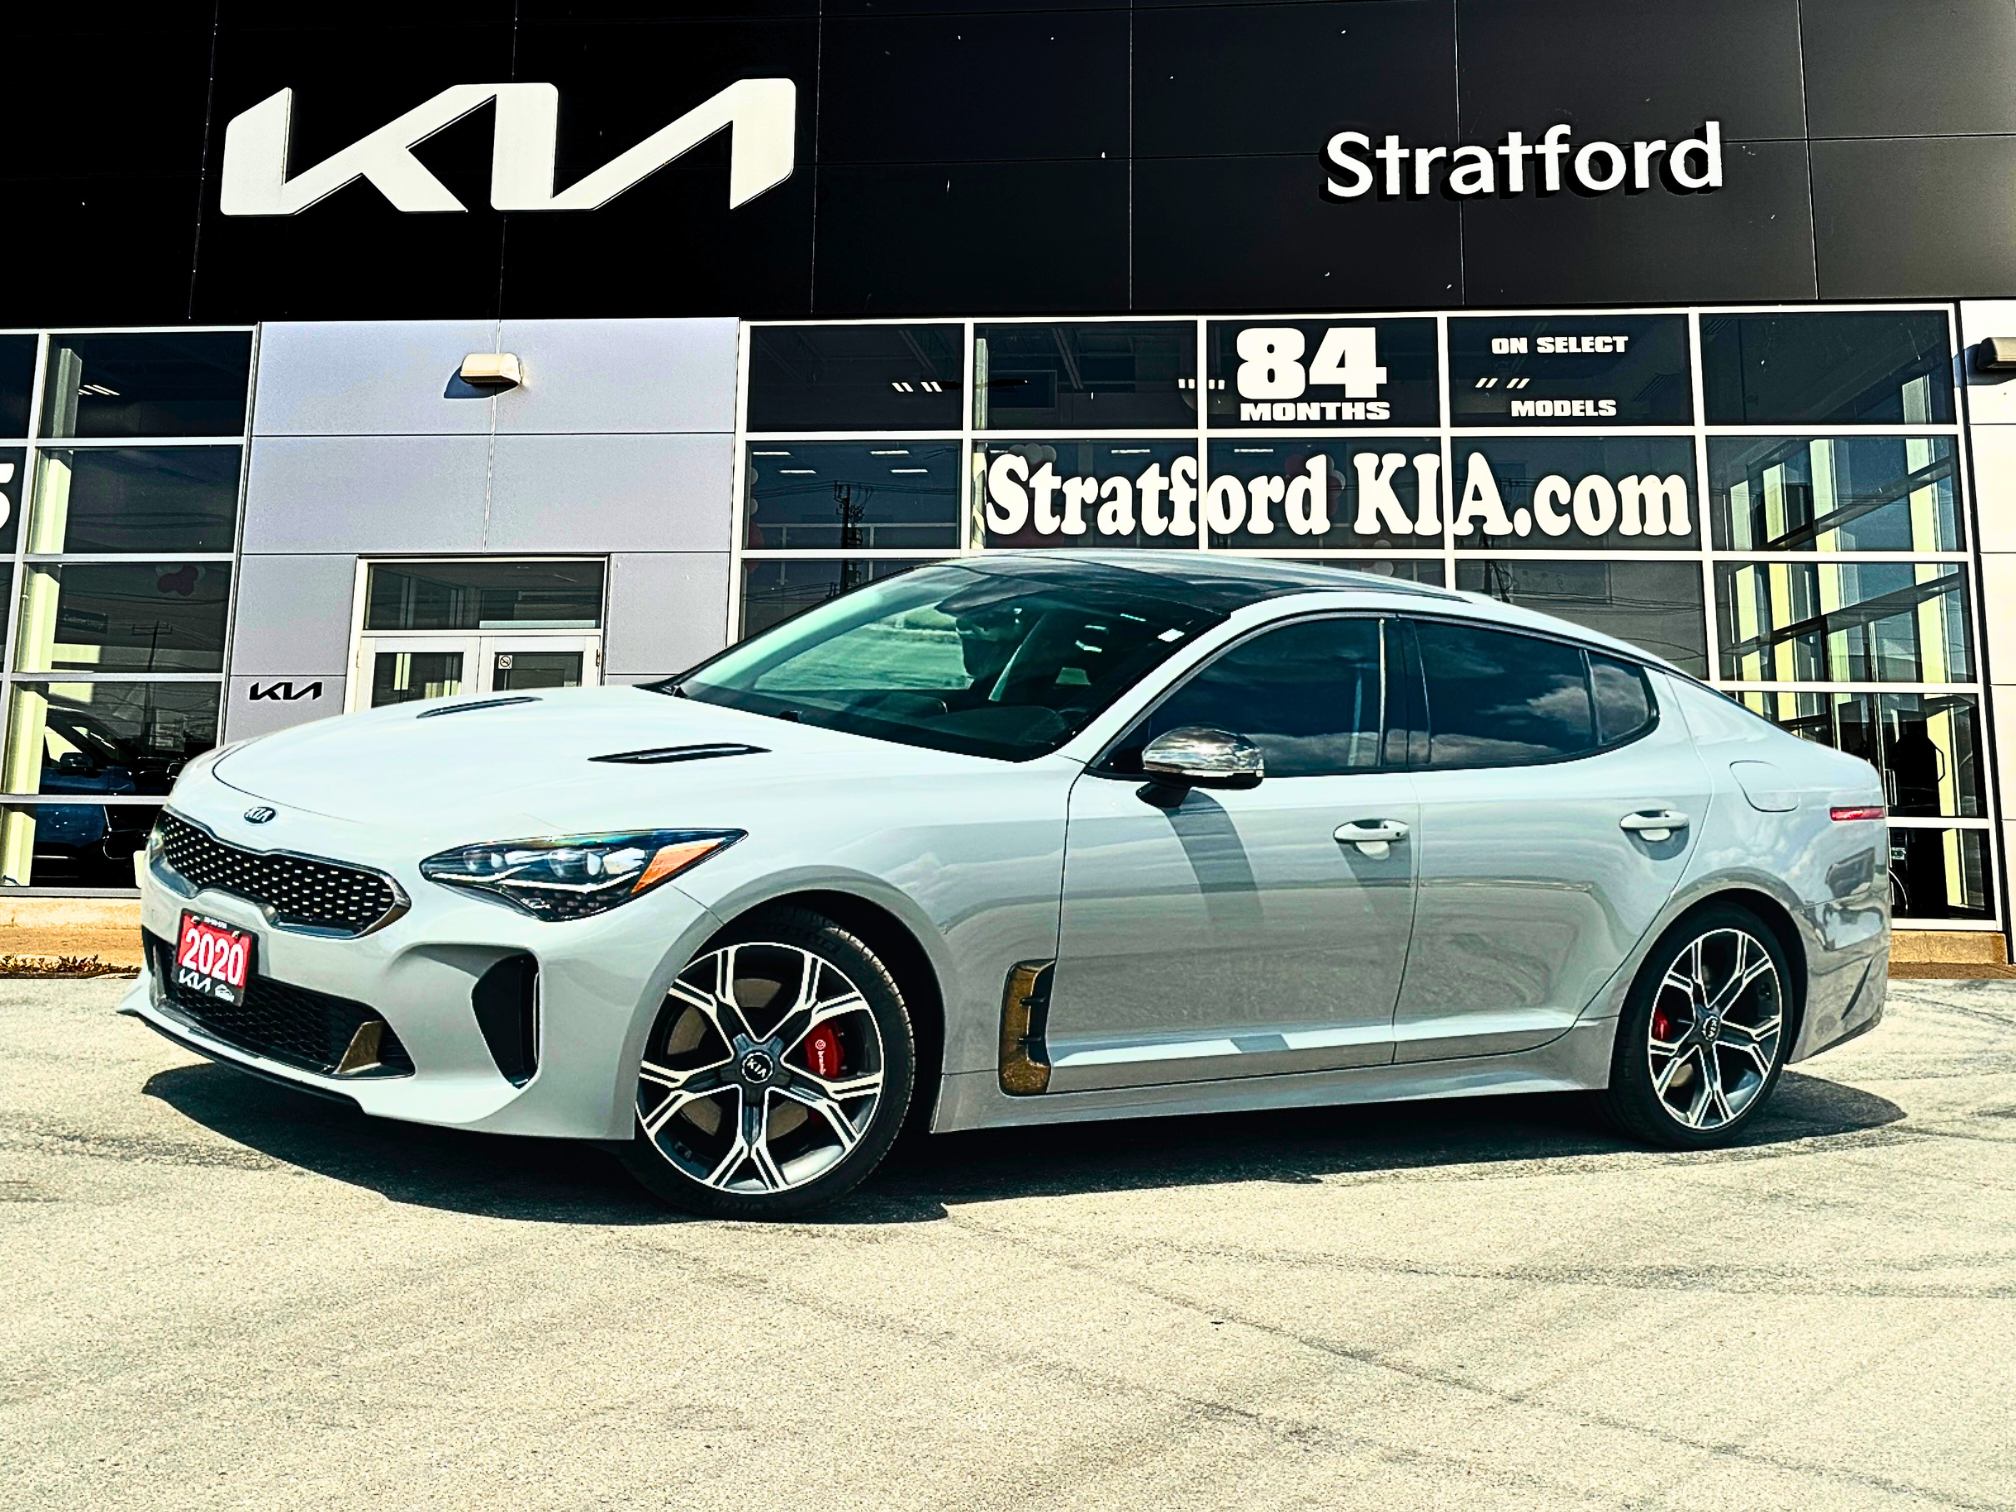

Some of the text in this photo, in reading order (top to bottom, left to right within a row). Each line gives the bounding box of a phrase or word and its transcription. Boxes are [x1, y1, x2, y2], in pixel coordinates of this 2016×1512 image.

[221, 78, 797, 216] KIA
[1325, 120, 1724, 199] Stratford
[1492, 335, 1629, 355] ON SELECT
[1236, 327, 1388, 400] 84
[1240, 402, 1391, 421] MONTHS
[1511, 400, 1617, 419] MODELS
[984, 452, 1692, 537] Stratford KIA.com
[249, 681, 323, 701] KIA
[245, 807, 273, 822] KIA
[181, 927, 244, 986] 2020
[746, 1058, 767, 1078] KIA
[817, 1050, 827, 1075] bremb
